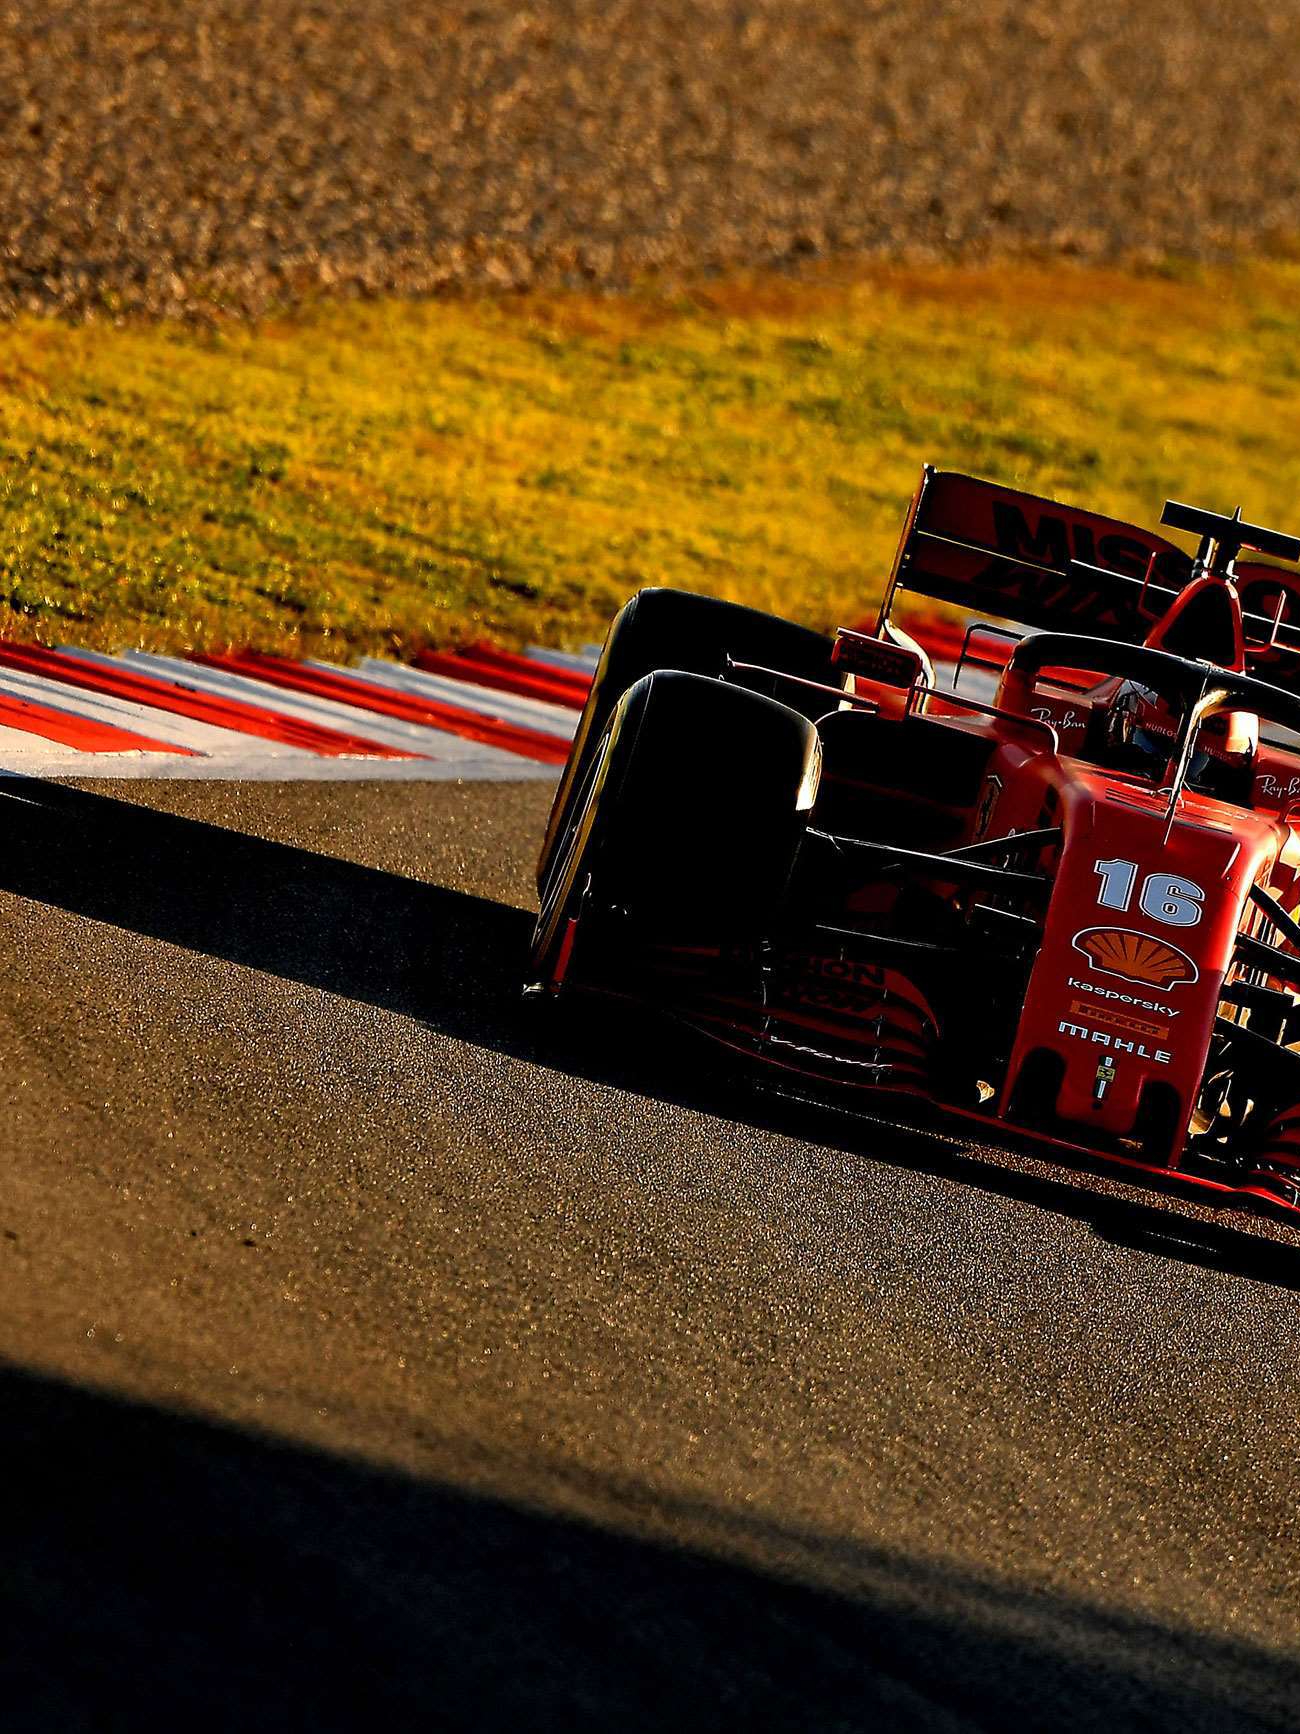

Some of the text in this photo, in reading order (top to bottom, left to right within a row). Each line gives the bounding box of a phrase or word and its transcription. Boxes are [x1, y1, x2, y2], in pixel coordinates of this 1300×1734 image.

[1093, 857, 1206, 927] 16
[1067, 977, 1181, 1017] kaspersky
[1058, 1021, 1172, 1064] MAHLE
